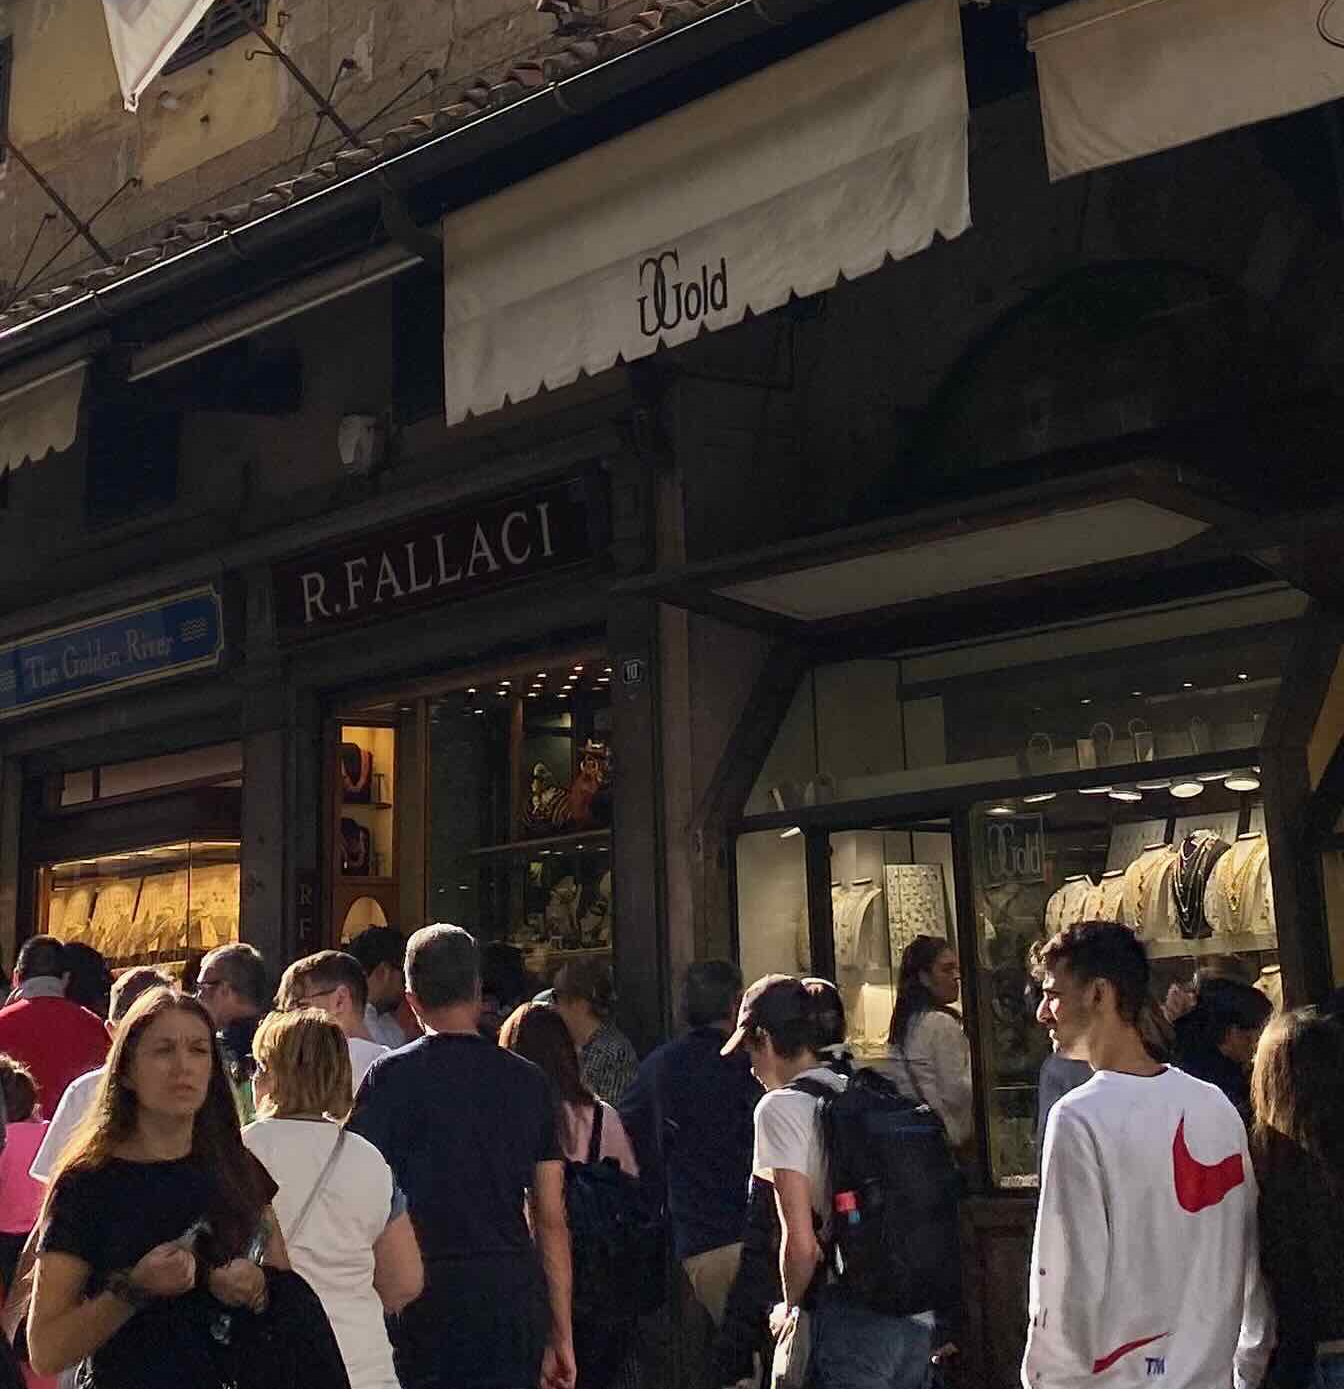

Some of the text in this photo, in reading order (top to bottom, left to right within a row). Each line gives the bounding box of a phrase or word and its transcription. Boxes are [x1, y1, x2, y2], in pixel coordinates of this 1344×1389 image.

[24, 628, 175, 689] The Golden River
